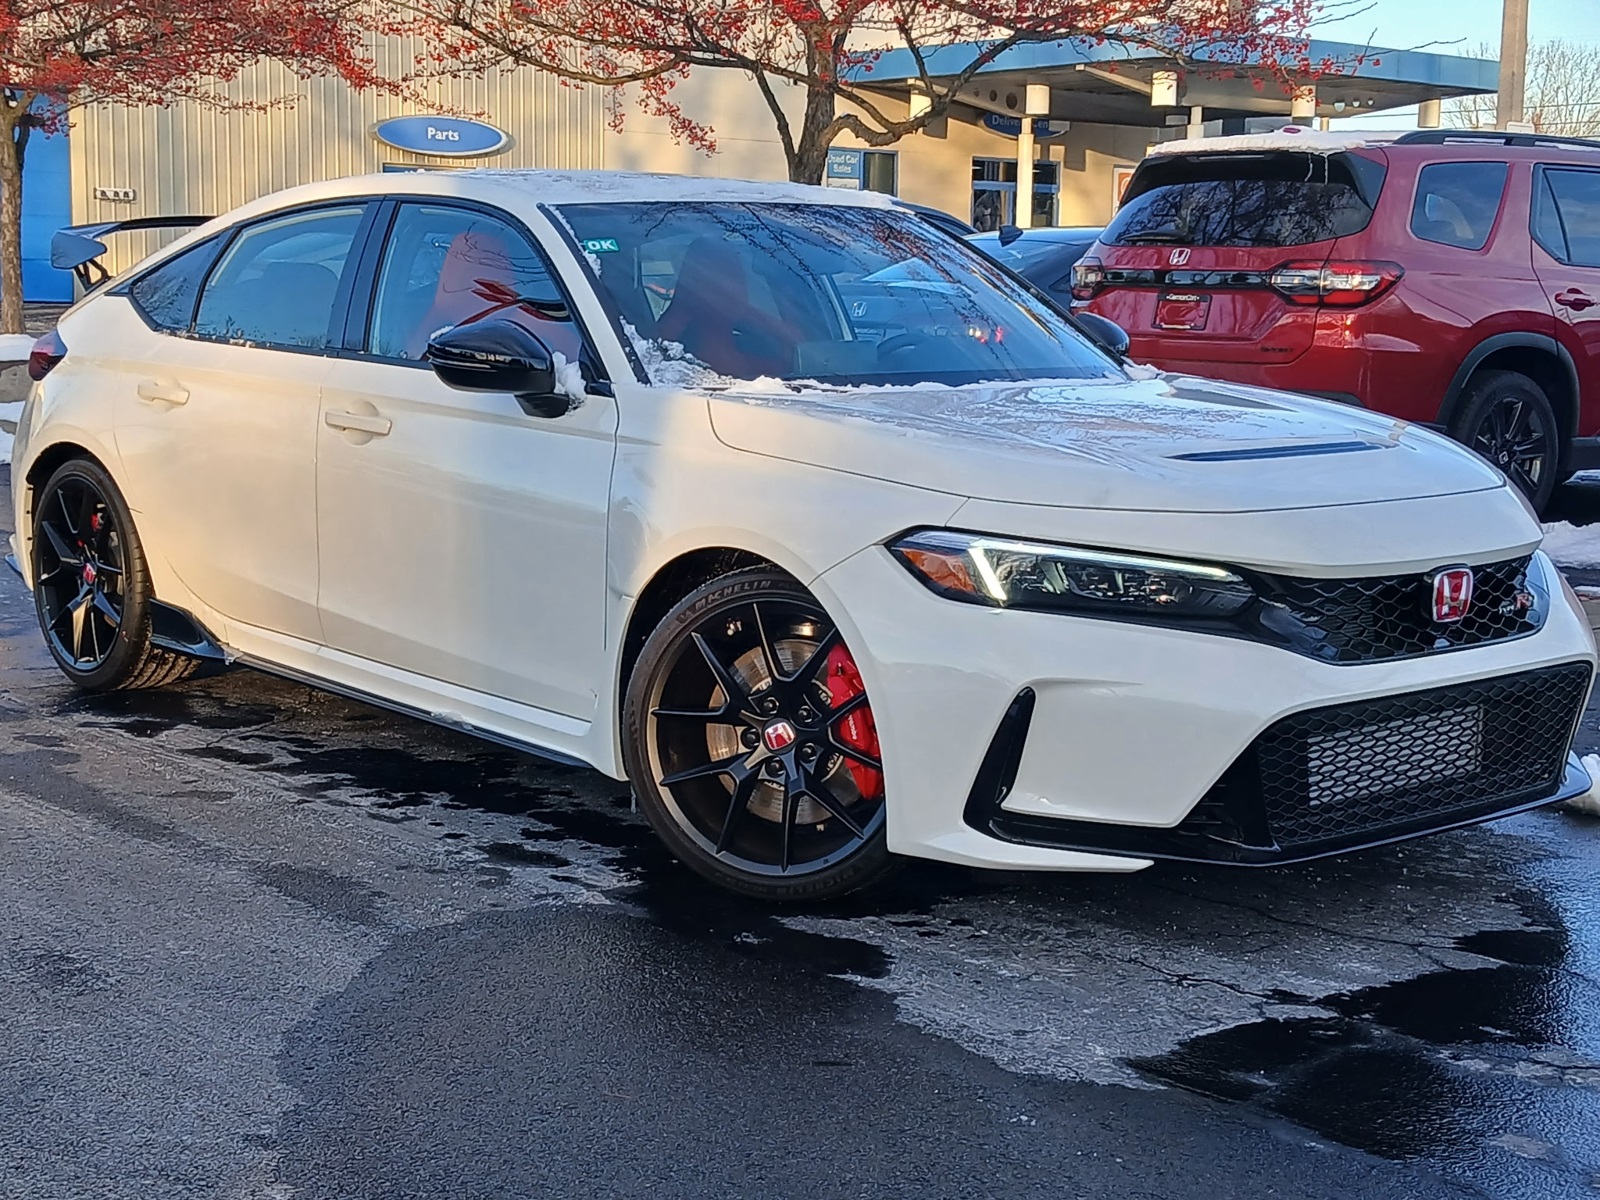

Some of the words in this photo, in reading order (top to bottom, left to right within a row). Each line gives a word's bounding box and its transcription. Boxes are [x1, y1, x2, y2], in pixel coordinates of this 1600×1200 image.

[427, 127, 460, 141] Parts
[845, 155, 859, 164] Car
[833, 164, 852, 173] Sales
[587, 240, 618, 250] OK
